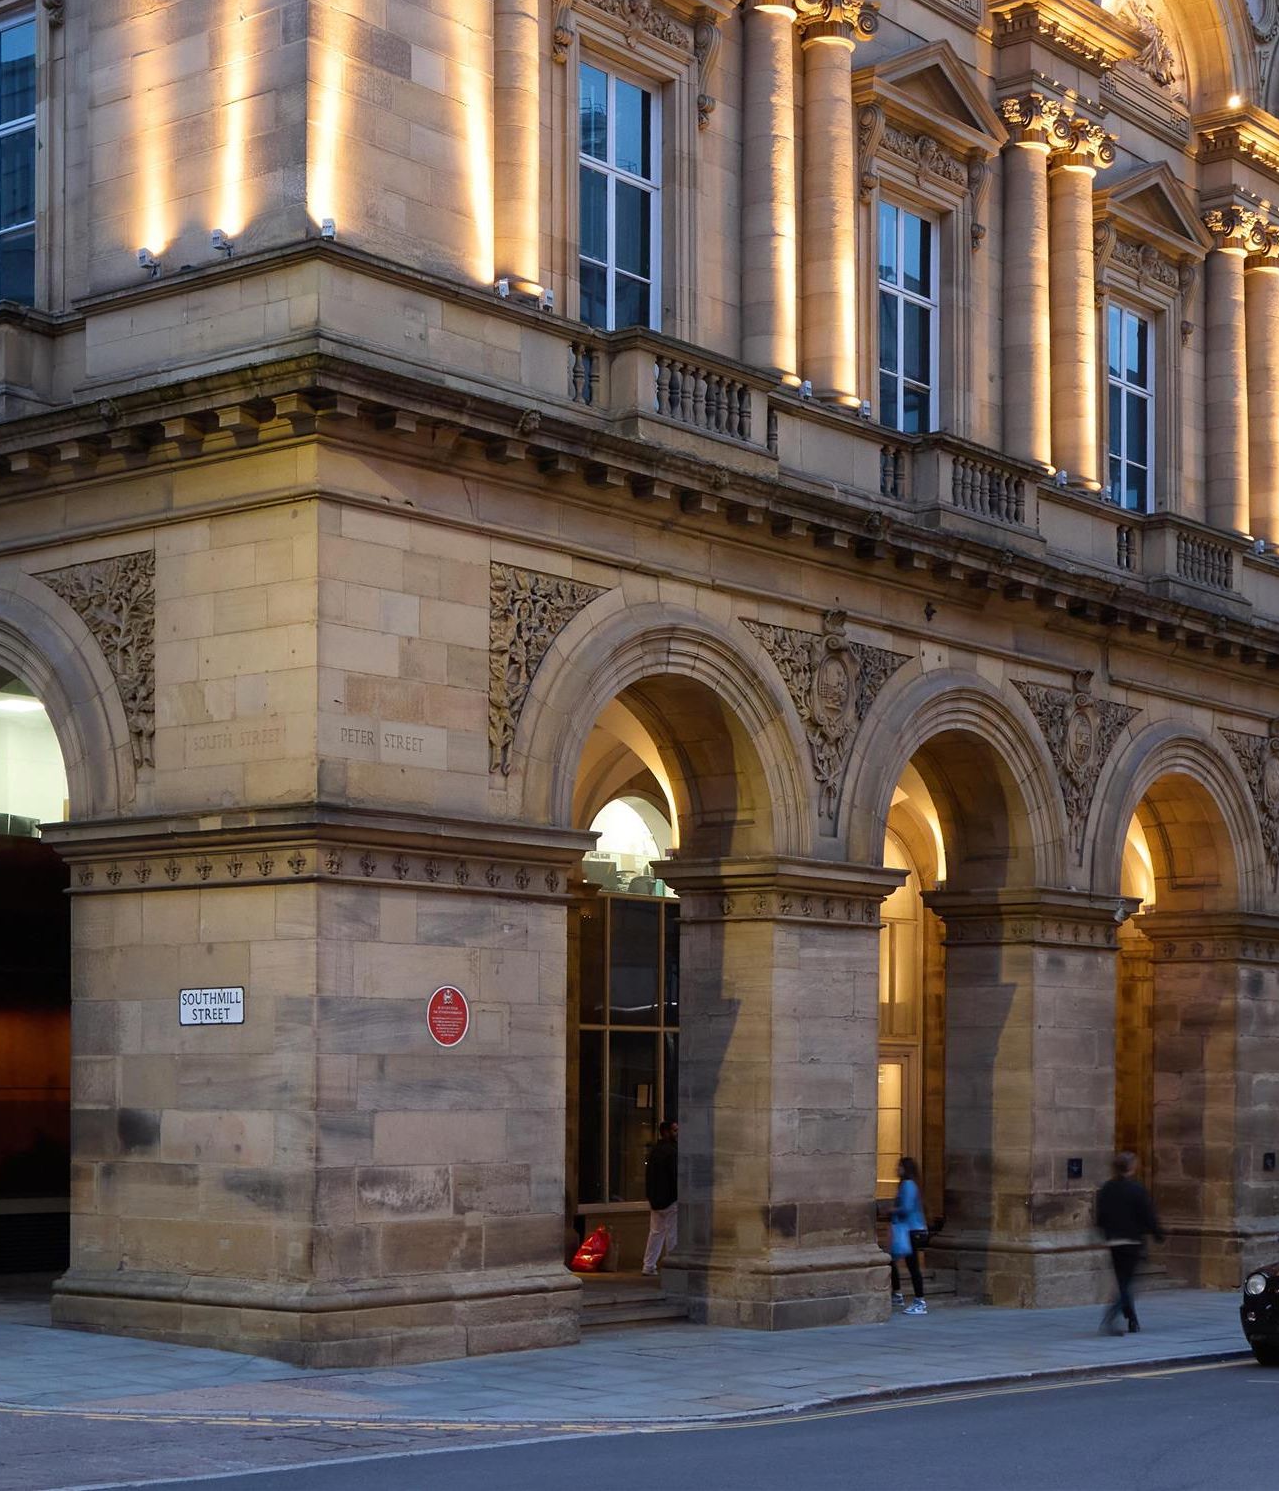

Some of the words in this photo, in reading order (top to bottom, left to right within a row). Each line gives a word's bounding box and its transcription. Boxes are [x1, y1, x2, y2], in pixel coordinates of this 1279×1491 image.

[341, 727, 375, 746] PETER
[384, 733, 425, 753] STREET
[181, 991, 242, 1006] SOUTHMILL
[192, 1007, 231, 1021] STREET
